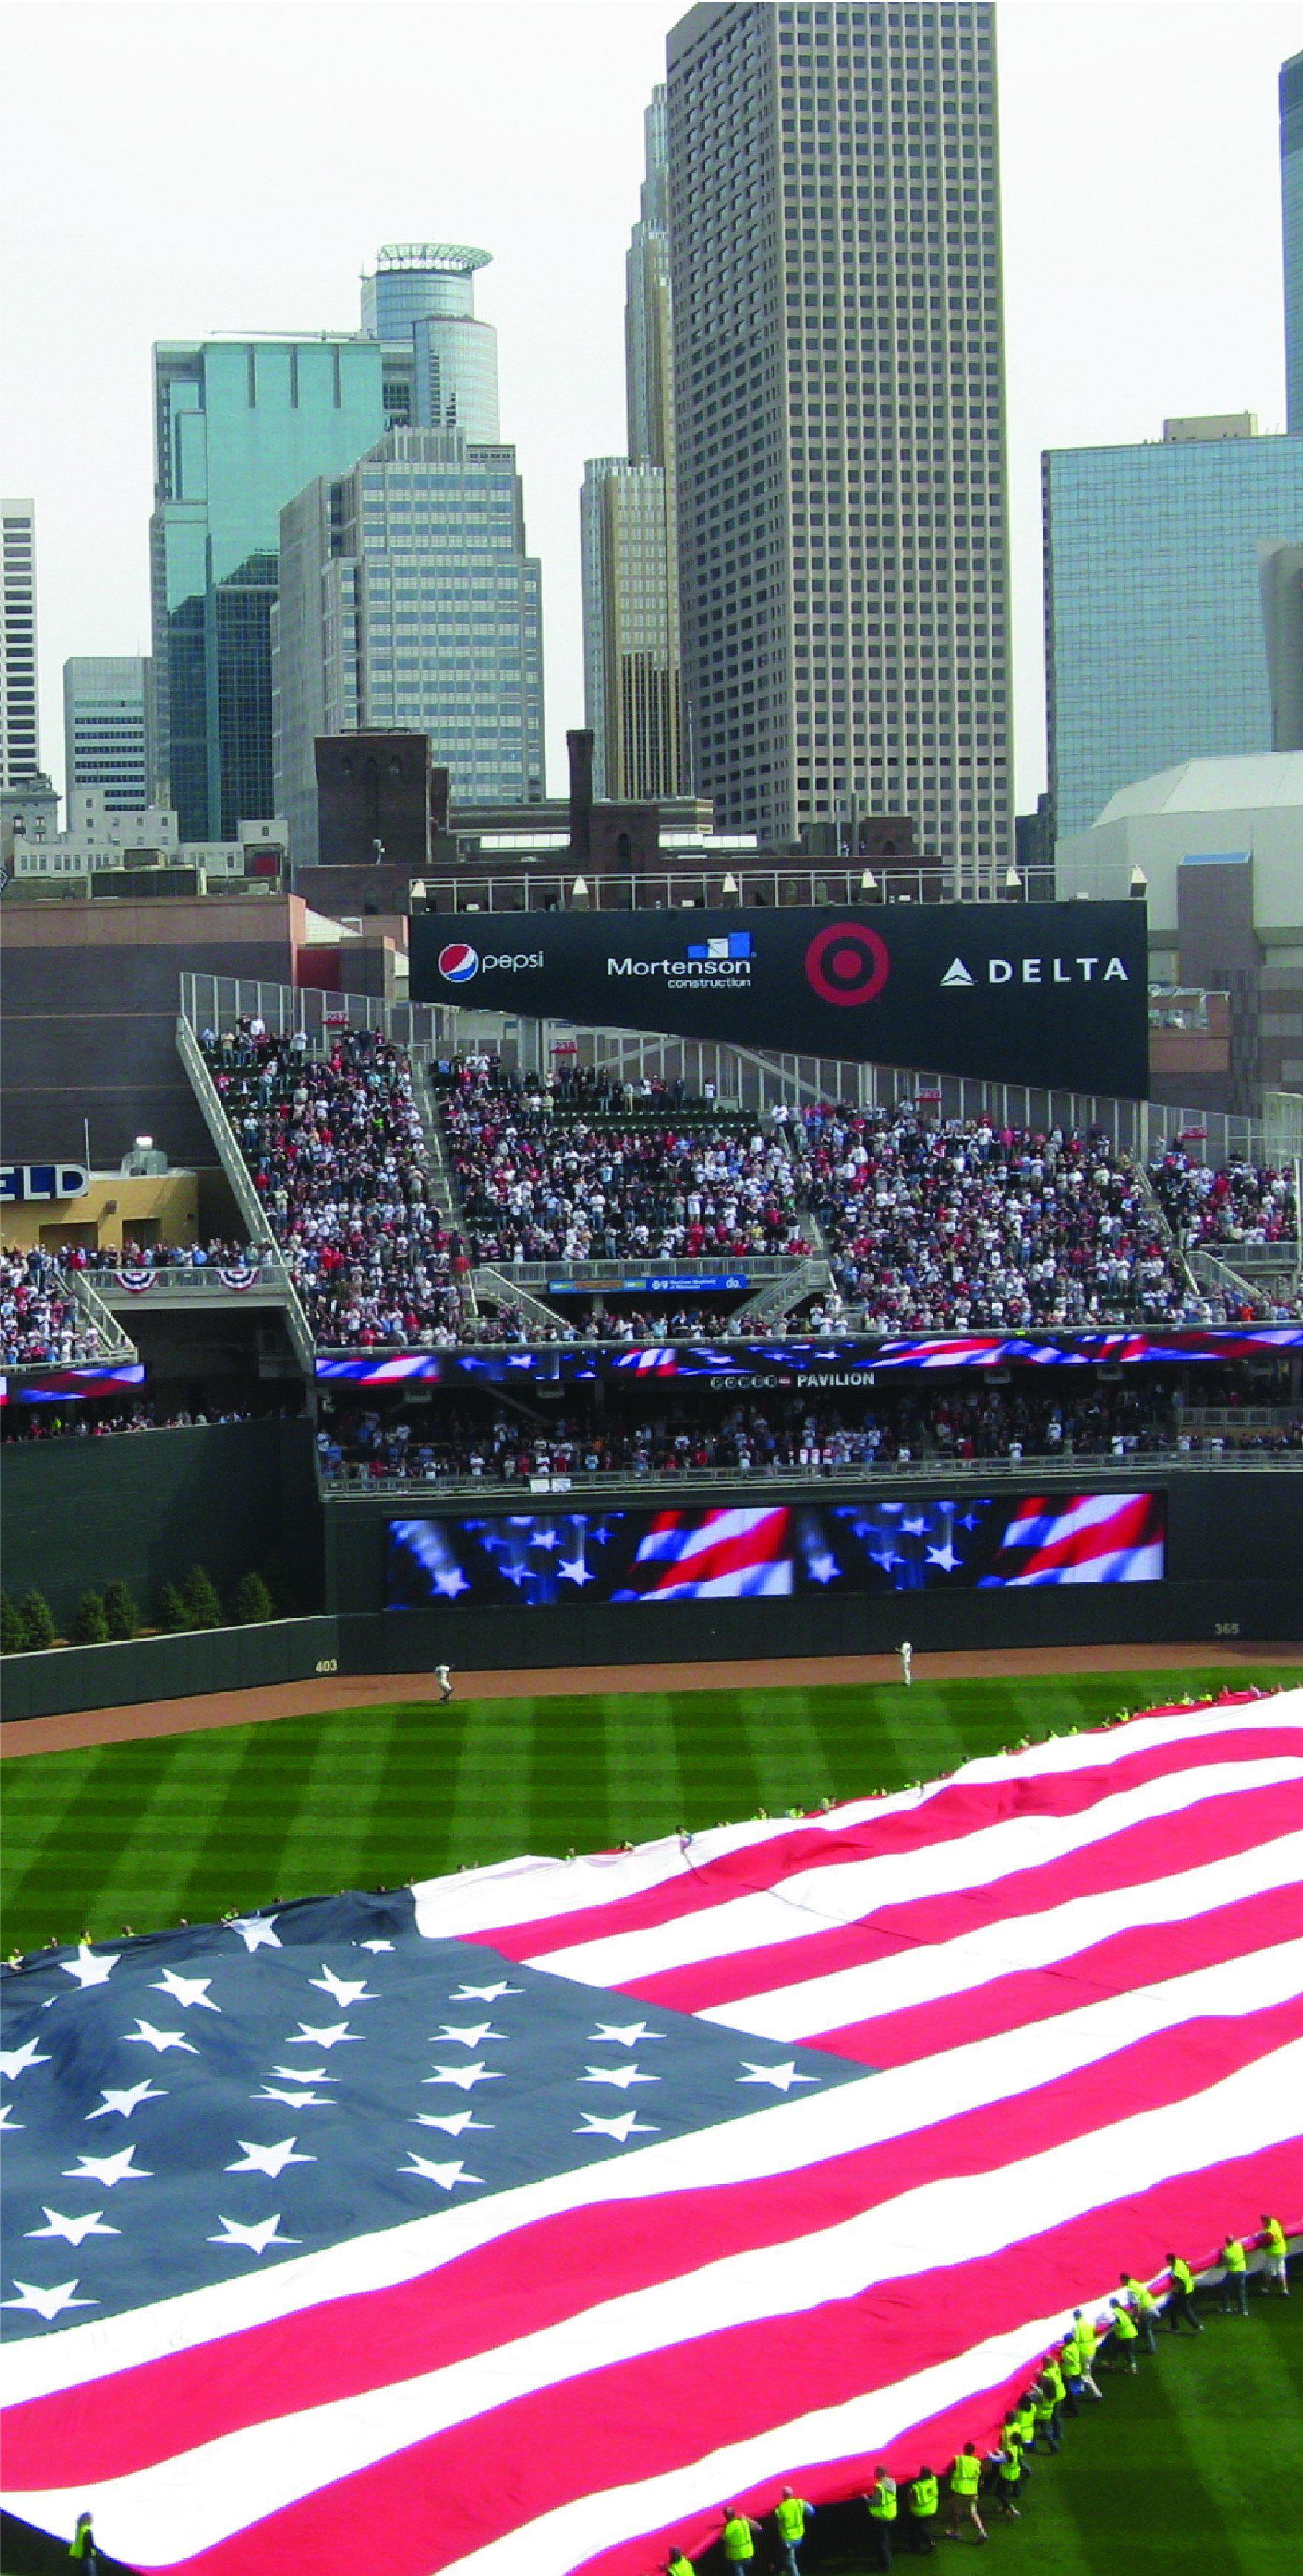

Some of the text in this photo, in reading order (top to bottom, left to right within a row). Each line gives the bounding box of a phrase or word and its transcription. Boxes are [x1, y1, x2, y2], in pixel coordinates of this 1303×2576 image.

[483, 950, 545, 973] pepsi
[607, 958, 751, 976] Mortenson
[989, 958, 1130, 983] DELTA
[668, 977, 750, 988] construction
[797, 1371, 875, 1388] PAVILION
[315, 1658, 338, 1672] 403
